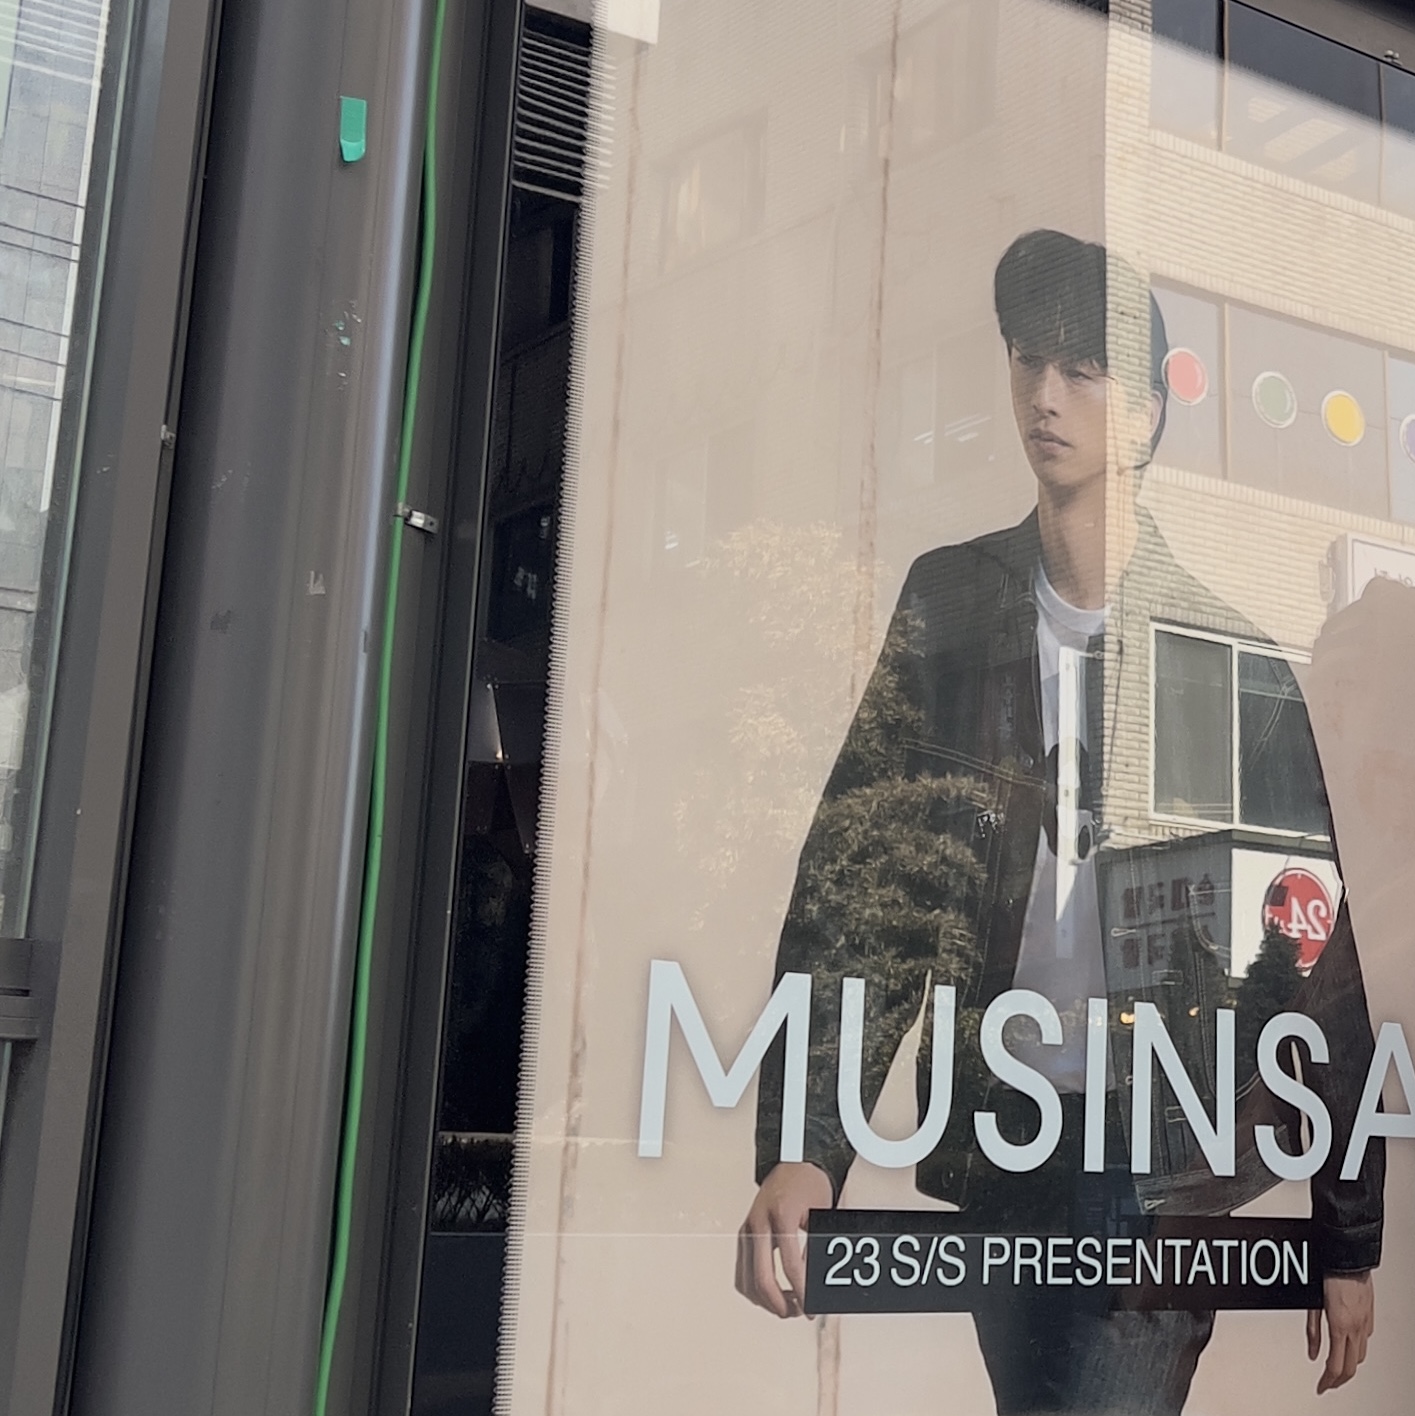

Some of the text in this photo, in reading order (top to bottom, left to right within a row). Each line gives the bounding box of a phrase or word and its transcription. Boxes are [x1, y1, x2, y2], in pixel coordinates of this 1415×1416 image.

[824, 1234, 1309, 1287] 23 S/S PRESENTATION
